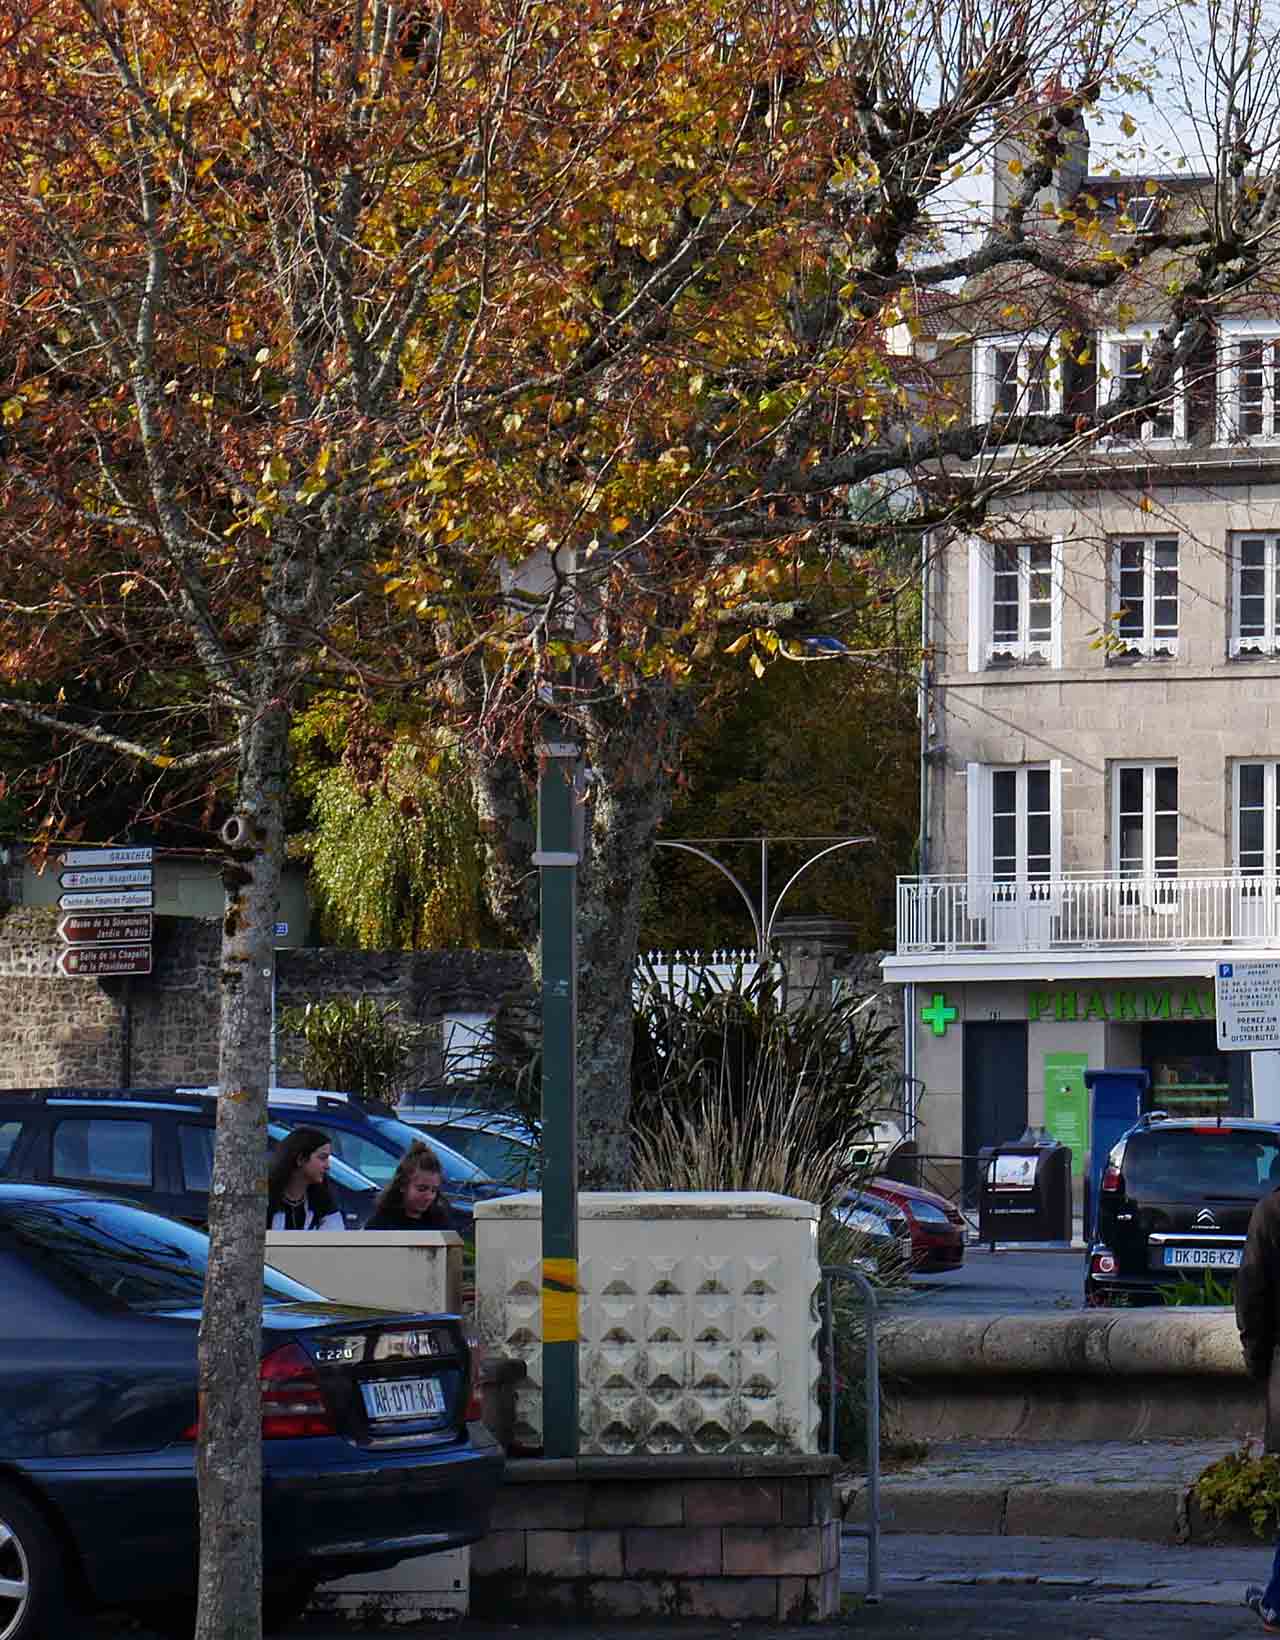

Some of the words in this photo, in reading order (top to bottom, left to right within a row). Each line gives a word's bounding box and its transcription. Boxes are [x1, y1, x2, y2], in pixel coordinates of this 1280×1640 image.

[80, 873, 104, 886] Centre
[108, 871, 151, 884] Hospitalier
[93, 918, 102, 928] de
[103, 917, 111, 927] la
[96, 928, 121, 939] Jardin
[124, 927, 150, 937] Public
[80, 951, 97, 961] Salle
[98, 951, 107, 960] de
[109, 951, 117, 959] la
[118, 949, 149, 961] Chapelle
[80, 962, 90, 972] de
[90, 962, 97, 971] la
[98, 960, 136, 972] Providence
[327, 1348, 353, 1359] 220
